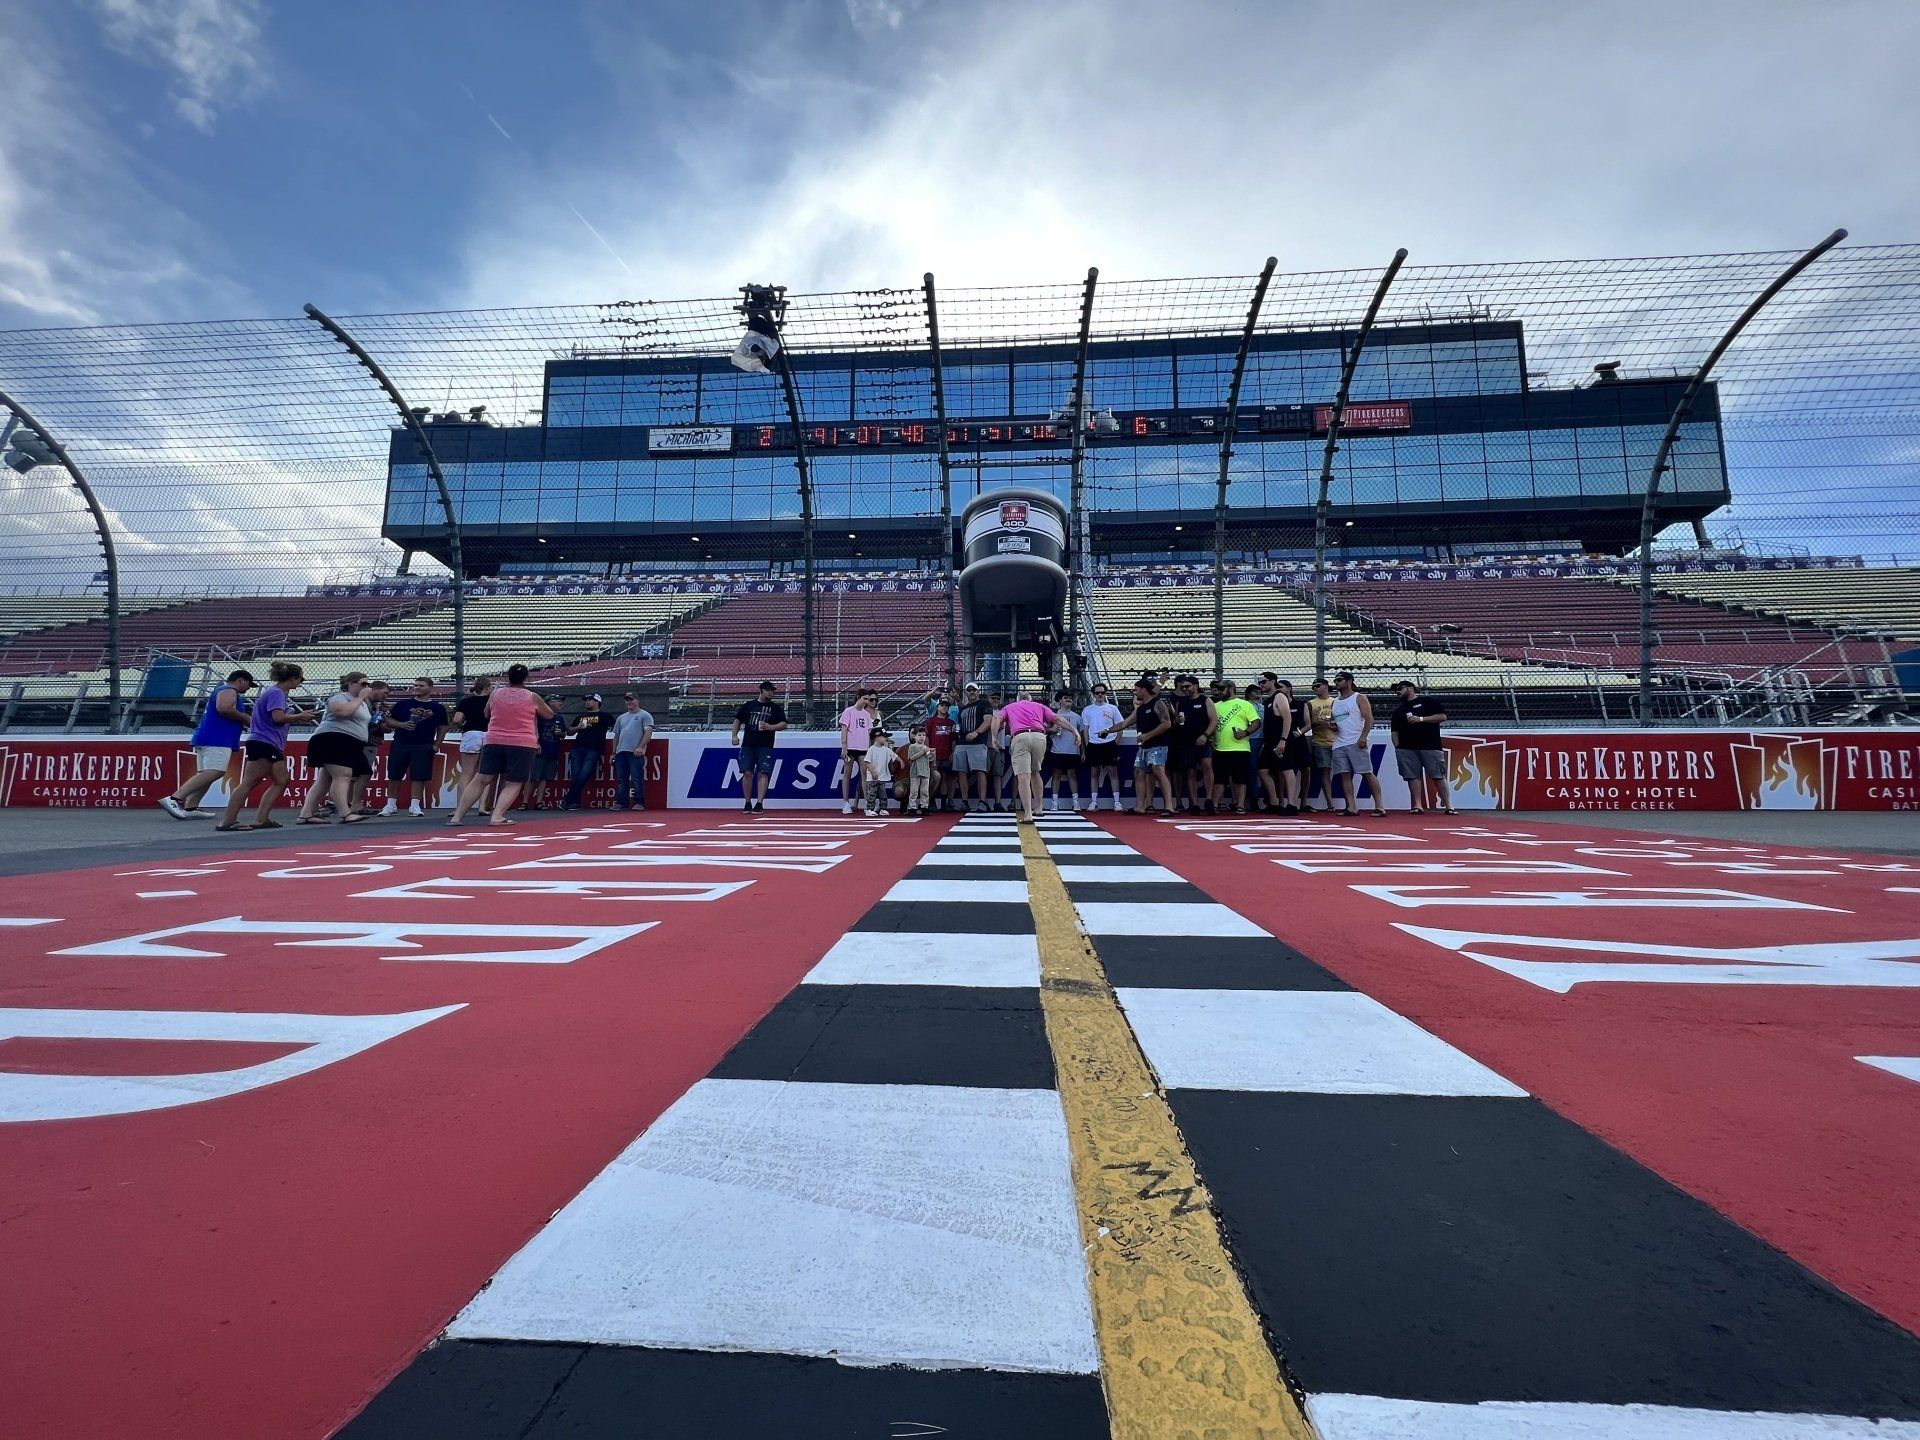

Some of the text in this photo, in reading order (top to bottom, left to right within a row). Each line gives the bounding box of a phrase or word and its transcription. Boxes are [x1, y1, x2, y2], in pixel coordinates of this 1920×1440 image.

[1353, 407, 1405, 419] FIREKEEPERS
[1135, 416, 1147, 435] 6
[665, 433, 711, 445] MICHIGAN
[760, 429, 772, 446] 2
[814, 427, 838, 445] 91
[857, 425, 881, 444] 07
[1108, 578, 1126, 588] ally
[1159, 577, 1177, 587] ally
[1264, 574, 1283, 584] ally
[1373, 571, 1392, 581] ally
[1428, 570, 1447, 580] ally
[1483, 569, 1502, 579] ally
[1539, 567, 1559, 577] ally
[1597, 565, 1617, 576] ally
[1656, 564, 1676, 575] ally
[1715, 562, 1735, 573] ally
[426, 587, 443, 598] ally
[472, 587, 489, 597] ally
[518, 586, 535, 595] ally
[568, 586, 585, 596] ally
[614, 585, 631, 595] ally
[662, 585, 679, 595] ally
[709, 583, 726, 593] ally
[757, 582, 775, 592] ally
[857, 583, 874, 592] ally
[906, 582, 923, 592] ally
[21, 752, 163, 782] FIREKEEPERS
[1526, 747, 1716, 780] FIREKEEPERS
[33, 787, 147, 798] CASINO HOTEL
[1546, 787, 1697, 798] CASINO HOTEL
[48, 799, 128, 807] BATTLE CREEK
[1569, 801, 1675, 810] BATTLE CREEK
